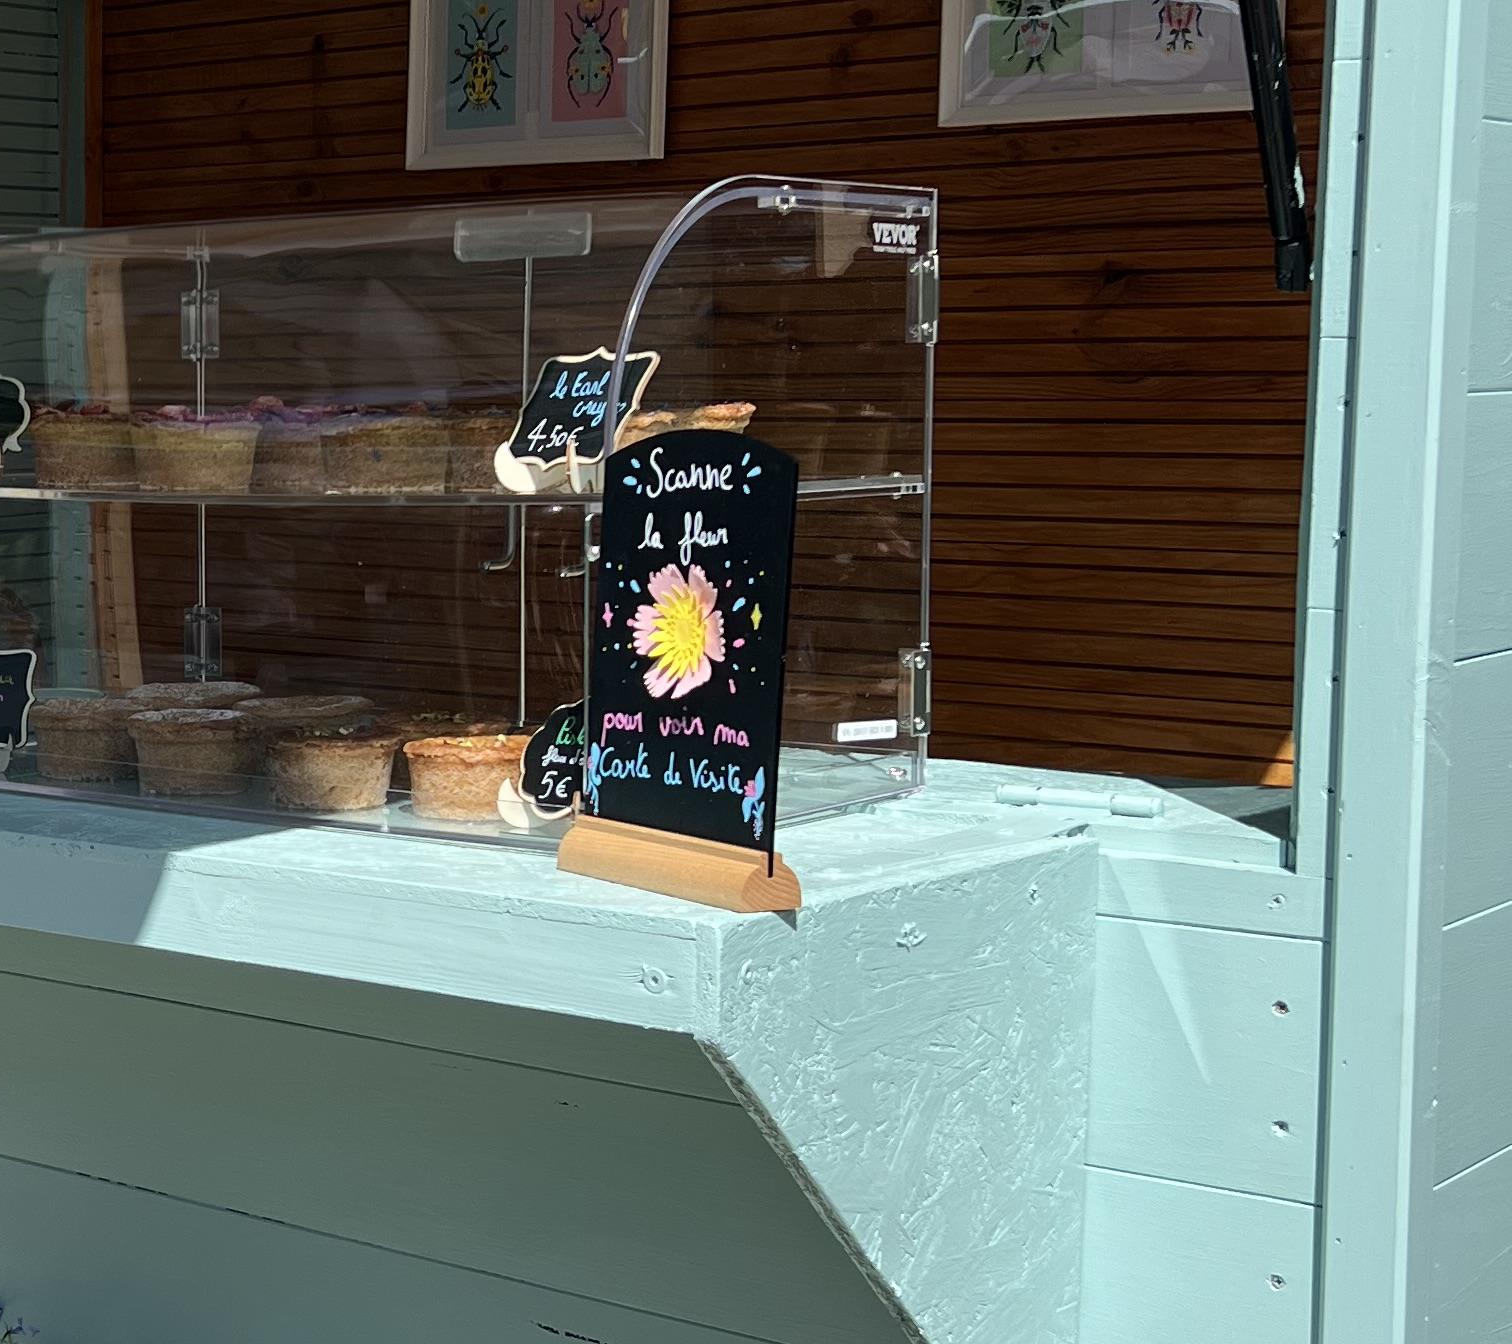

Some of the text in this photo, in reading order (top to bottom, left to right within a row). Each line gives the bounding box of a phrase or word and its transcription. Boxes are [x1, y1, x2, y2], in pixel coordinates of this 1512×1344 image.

[872, 222, 918, 246] VEVOR
[646, 446, 734, 498] Scanne
[638, 510, 728, 566] la fleur
[600, 711, 750, 747] pour voir ma
[599, 742, 743, 795] Carte de Visite
